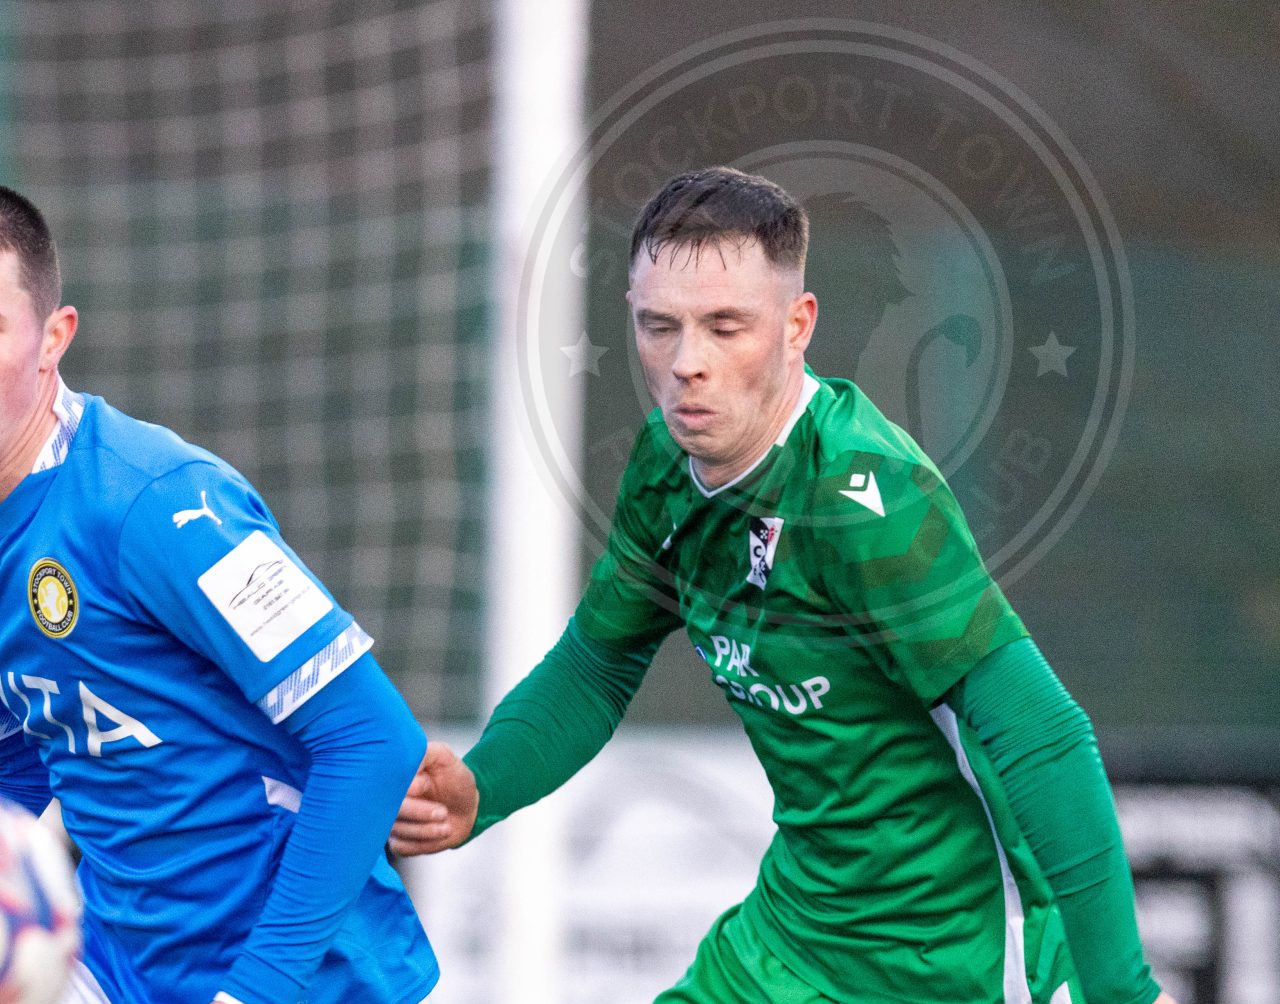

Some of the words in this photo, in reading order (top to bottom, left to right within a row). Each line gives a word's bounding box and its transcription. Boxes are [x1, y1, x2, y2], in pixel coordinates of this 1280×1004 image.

[32, 567, 57, 594] STOCKPORT
[57, 572, 73, 594] TOWN
[37, 609, 62, 631] FOOTBALL
[61, 610, 74, 629] CLUB
